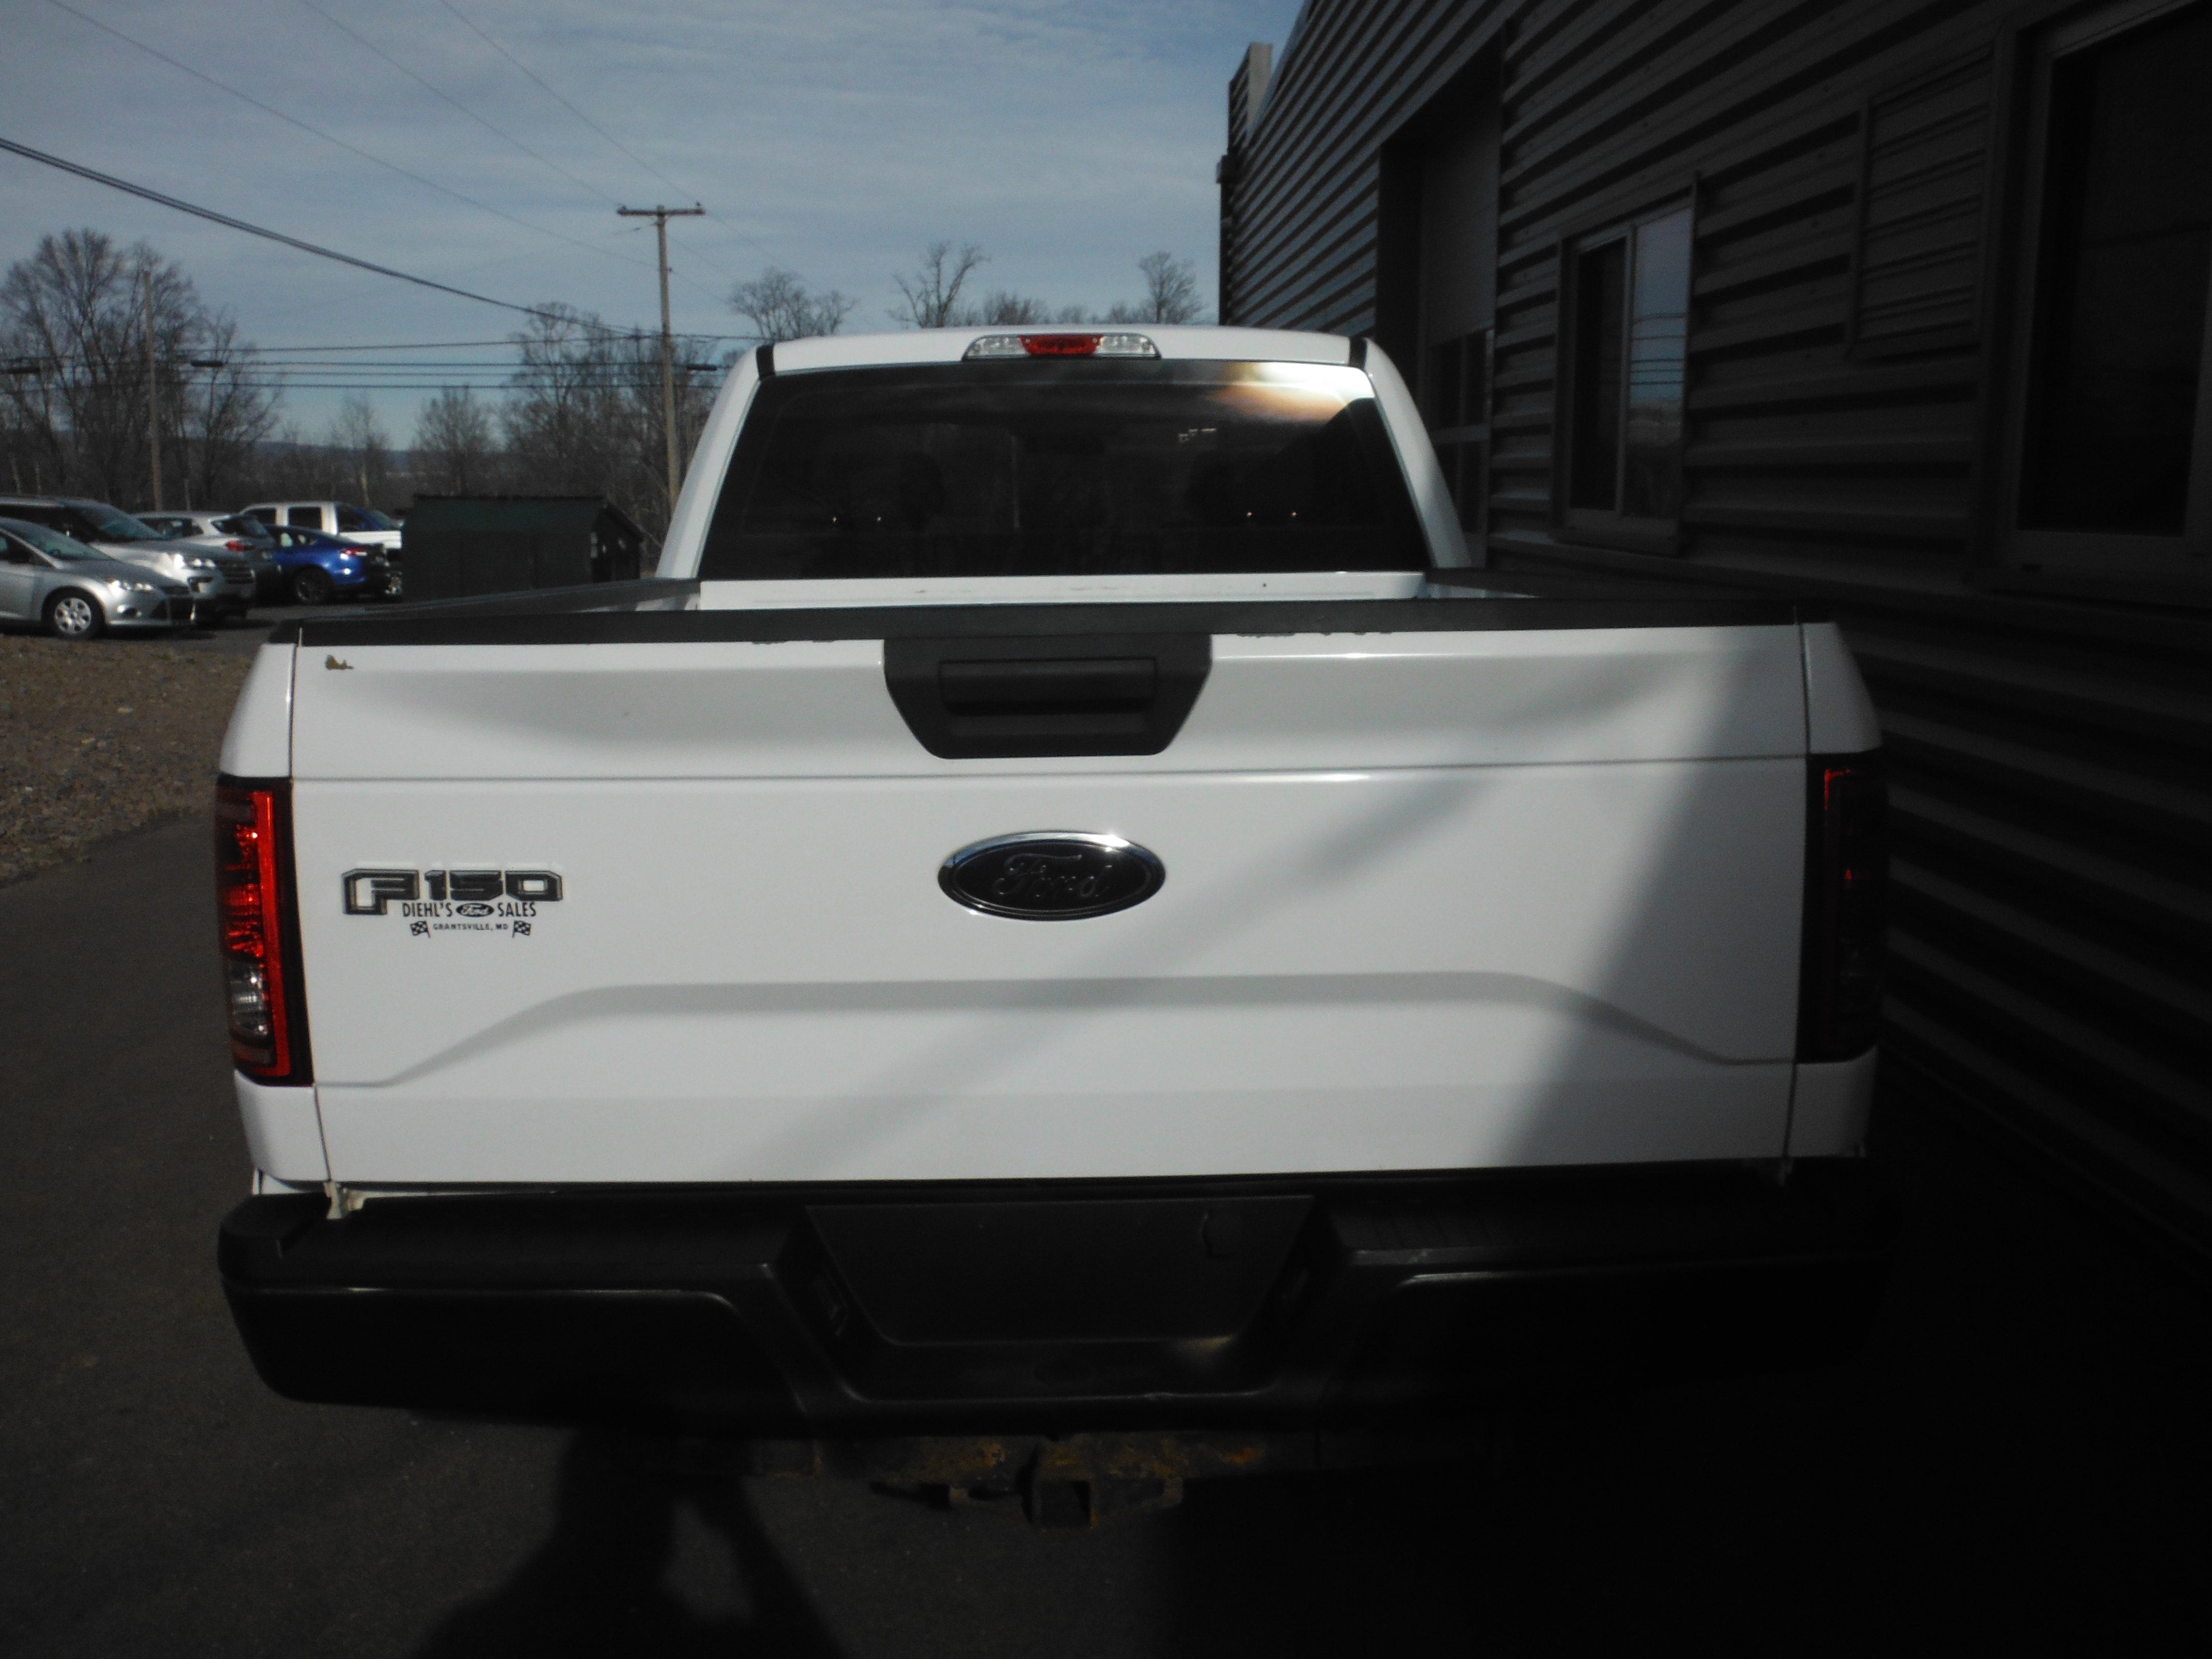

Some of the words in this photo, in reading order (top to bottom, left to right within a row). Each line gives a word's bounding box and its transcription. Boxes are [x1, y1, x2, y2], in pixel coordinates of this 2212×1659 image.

[991, 852, 1113, 899] Ford
[402, 902, 453, 917] DIEHL'S
[497, 902, 536, 917] SALES
